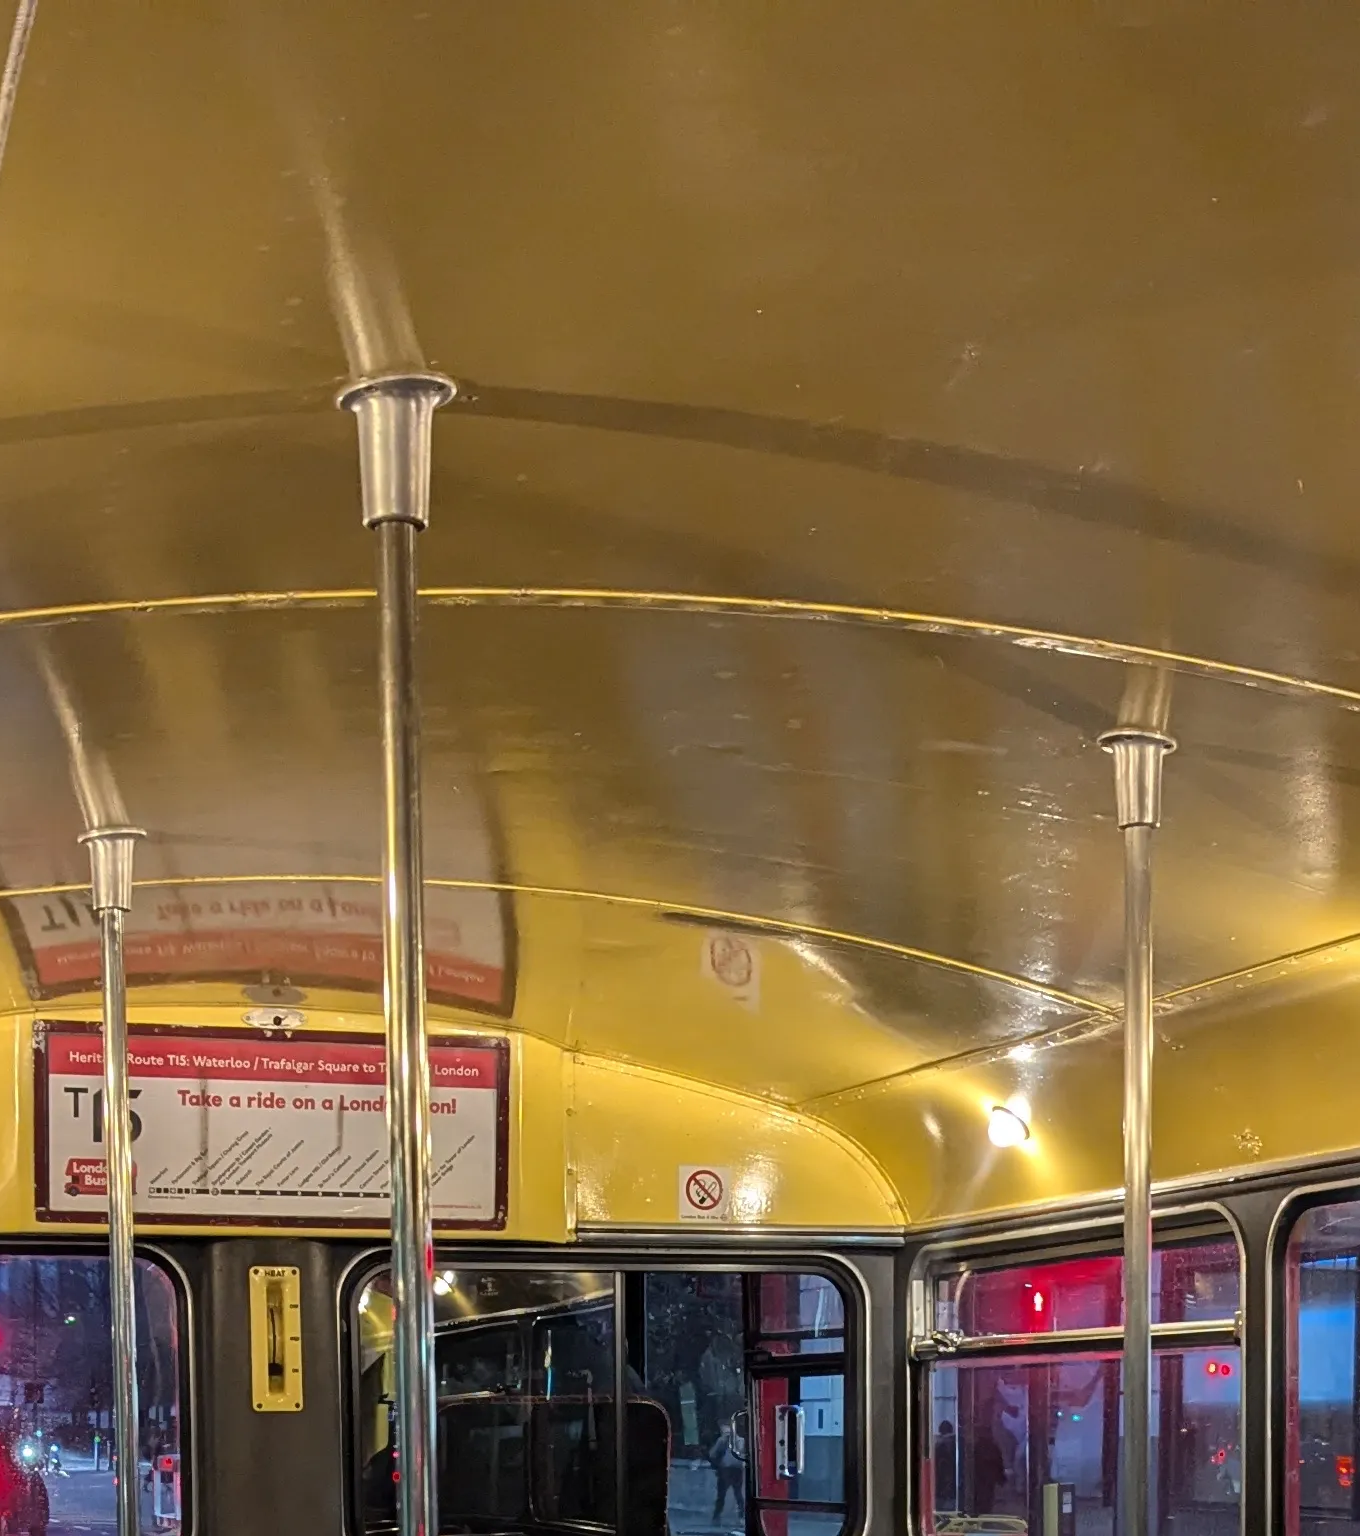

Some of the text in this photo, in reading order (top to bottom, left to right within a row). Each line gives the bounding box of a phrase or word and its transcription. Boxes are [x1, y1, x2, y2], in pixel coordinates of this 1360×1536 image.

[69, 1051, 103, 1063] Herit
[127, 1054, 164, 1067] Route
[167, 1054, 190, 1067] T15:
[193, 1055, 250, 1069] Waterloo
[261, 1057, 314, 1074] Trafalgar
[317, 1060, 359, 1075] Square
[363, 1062, 376, 1073] to
[434, 1065, 479, 1077] London
[177, 1089, 222, 1108] Take
[229, 1095, 241, 1108] a
[247, 1091, 286, 1109] ride
[292, 1097, 316, 1110] on
[322, 1098, 334, 1111] a
[340, 1094, 387, 1113] Lond
[264, 1269, 286, 1278] HEAT
